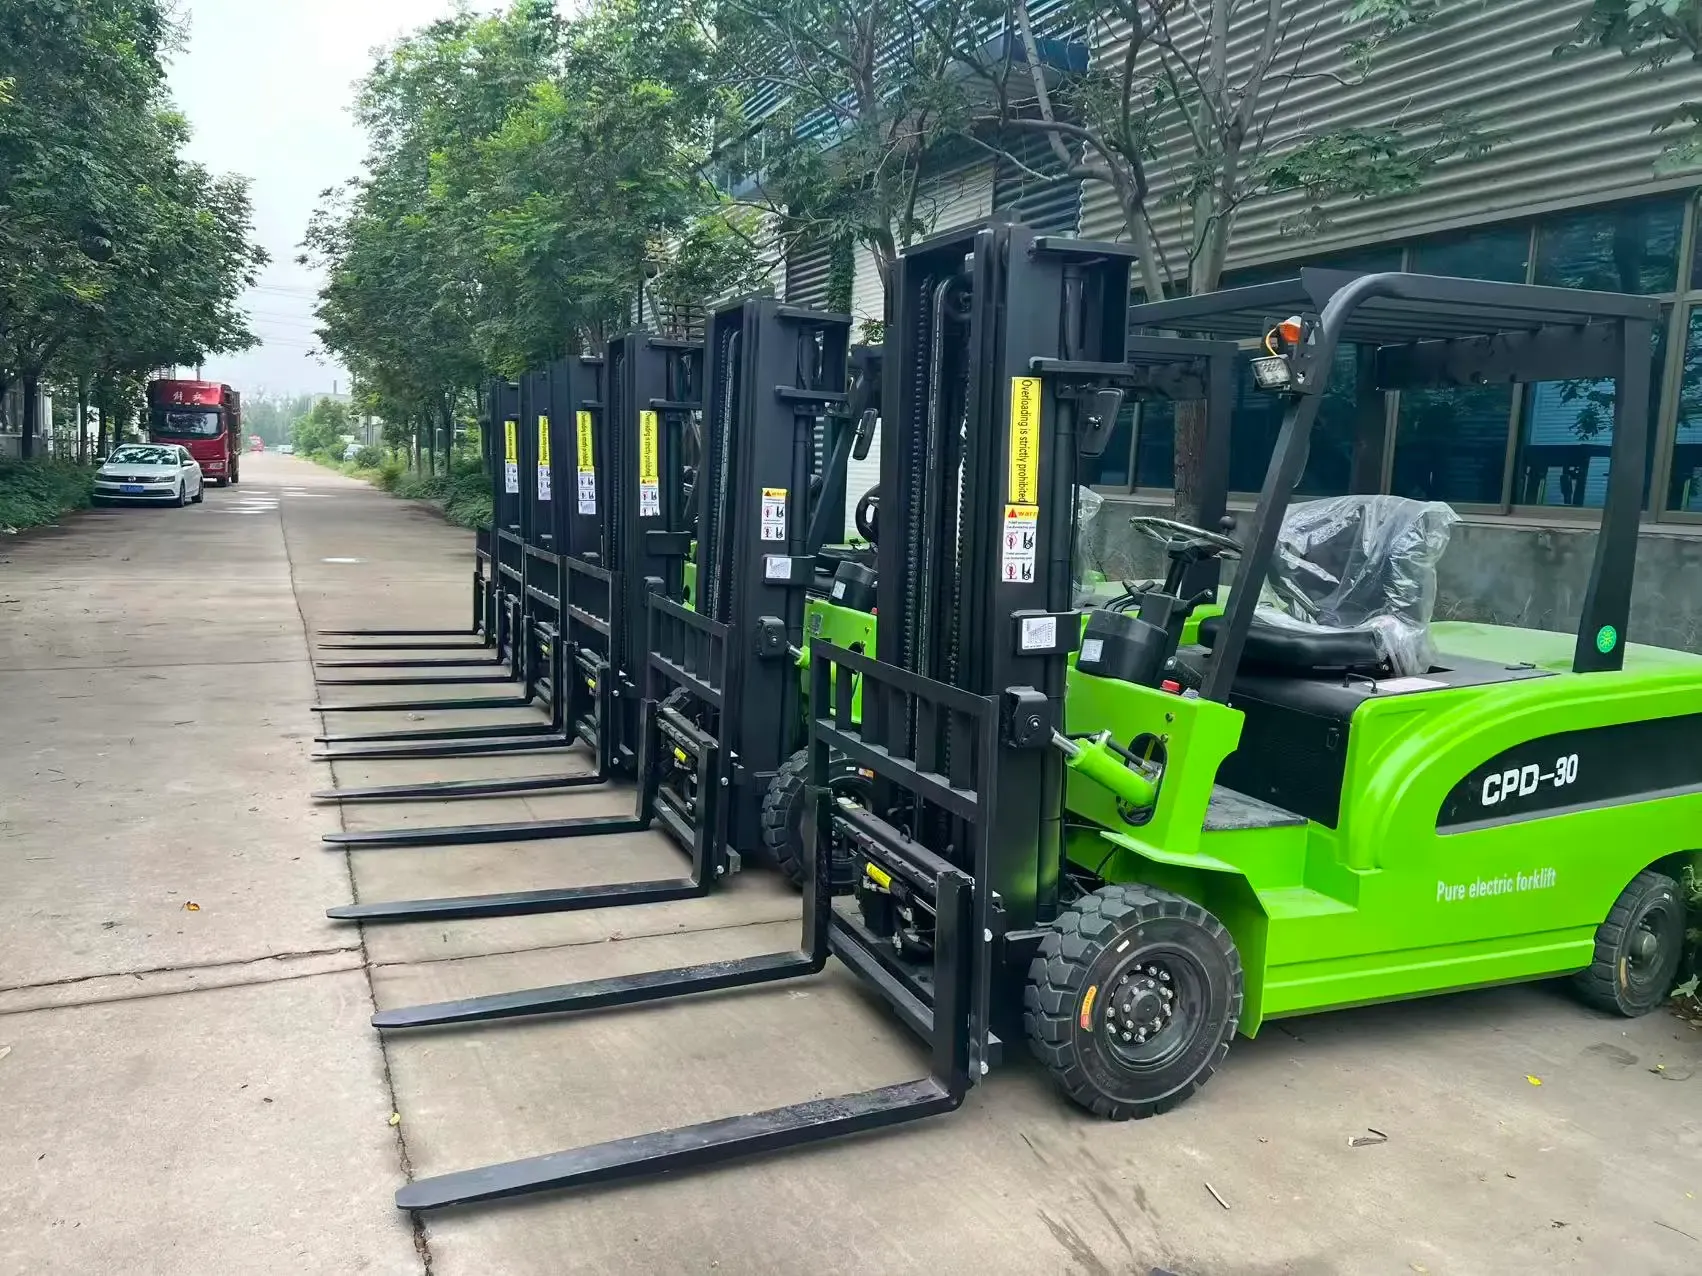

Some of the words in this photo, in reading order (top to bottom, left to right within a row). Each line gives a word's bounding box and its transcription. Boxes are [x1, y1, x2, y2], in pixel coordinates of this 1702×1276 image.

[1018, 380, 1032, 426] Overloading
[1016, 435, 1031, 462] strictly
[1020, 427, 1031, 435] is
[1016, 463, 1029, 503] prohibited
[1481, 753, 1579, 806] CPD-30
[1436, 880, 1466, 903] Pure
[1469, 873, 1514, 898] electric
[1516, 867, 1557, 893] forklift
